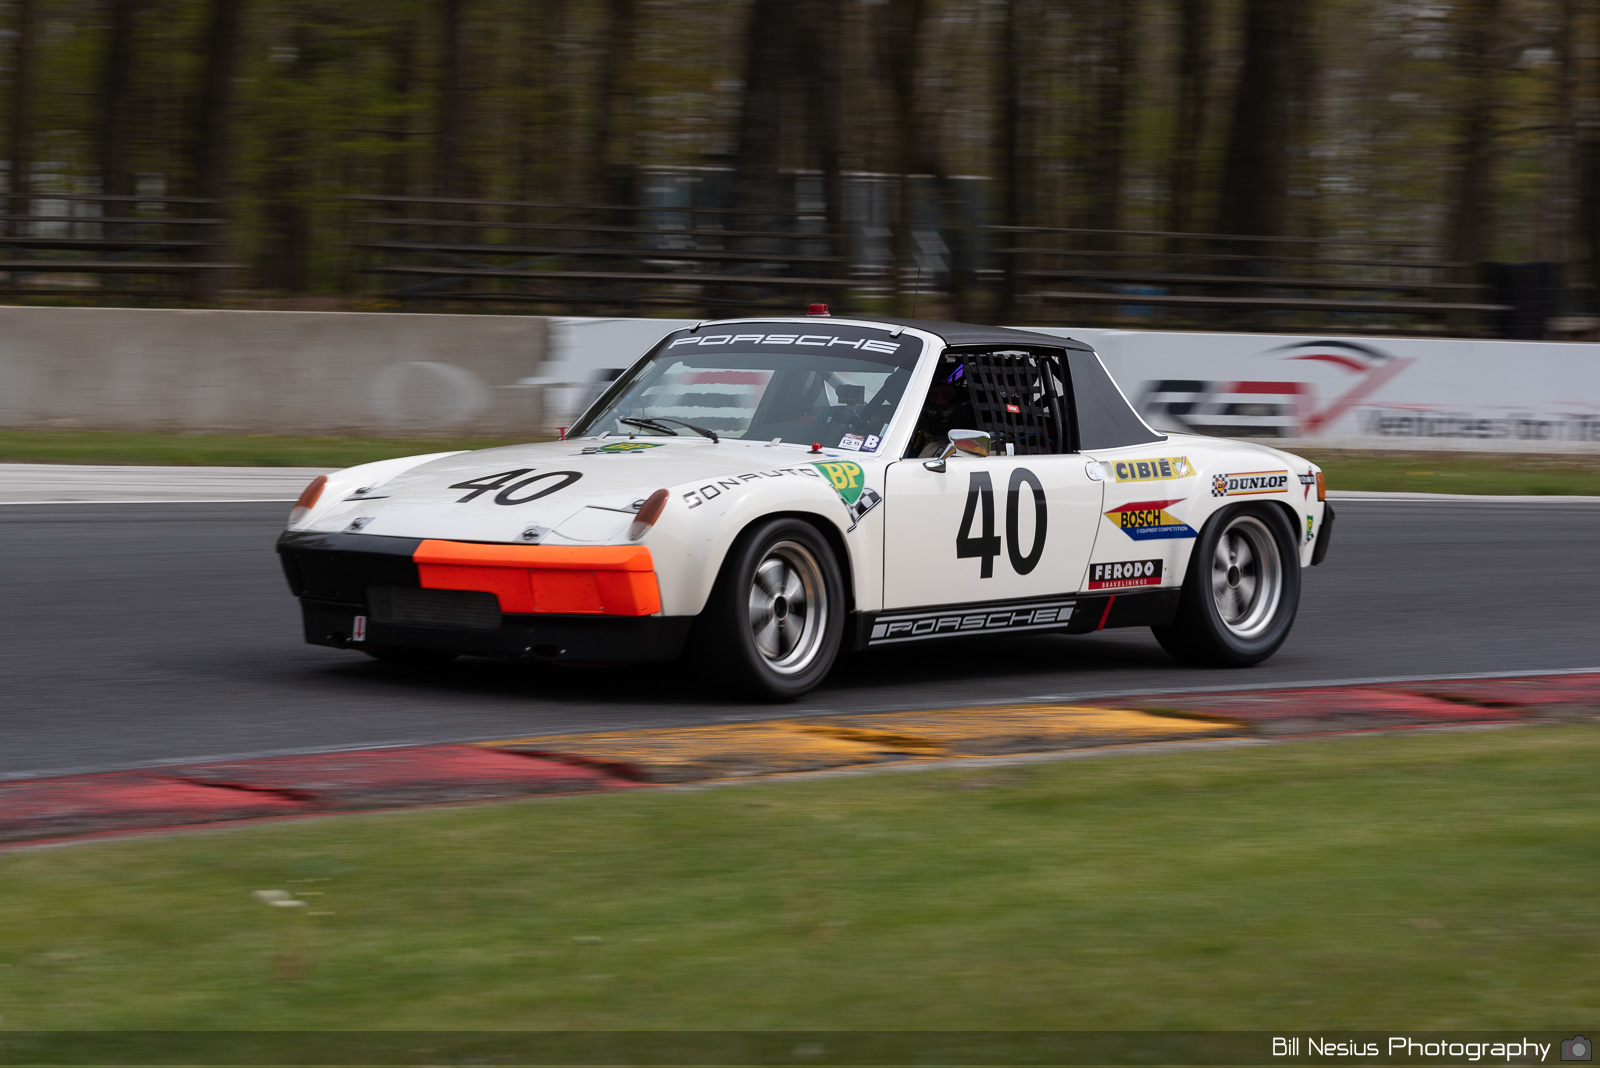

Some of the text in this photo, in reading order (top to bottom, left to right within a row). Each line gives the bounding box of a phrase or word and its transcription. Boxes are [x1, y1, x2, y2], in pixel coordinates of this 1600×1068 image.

[668, 333, 900, 355] PORSCHE
[863, 434, 880, 449] B
[448, 468, 583, 505] 40
[823, 462, 861, 490] BP
[1227, 475, 1288, 491] DUNLOP
[682, 468, 820, 510] SONAUTO
[956, 467, 1048, 579] 40
[1120, 509, 1161, 528] BOSCH
[1095, 561, 1155, 580] FERODO
[886, 607, 1058, 637] PORSCHE
